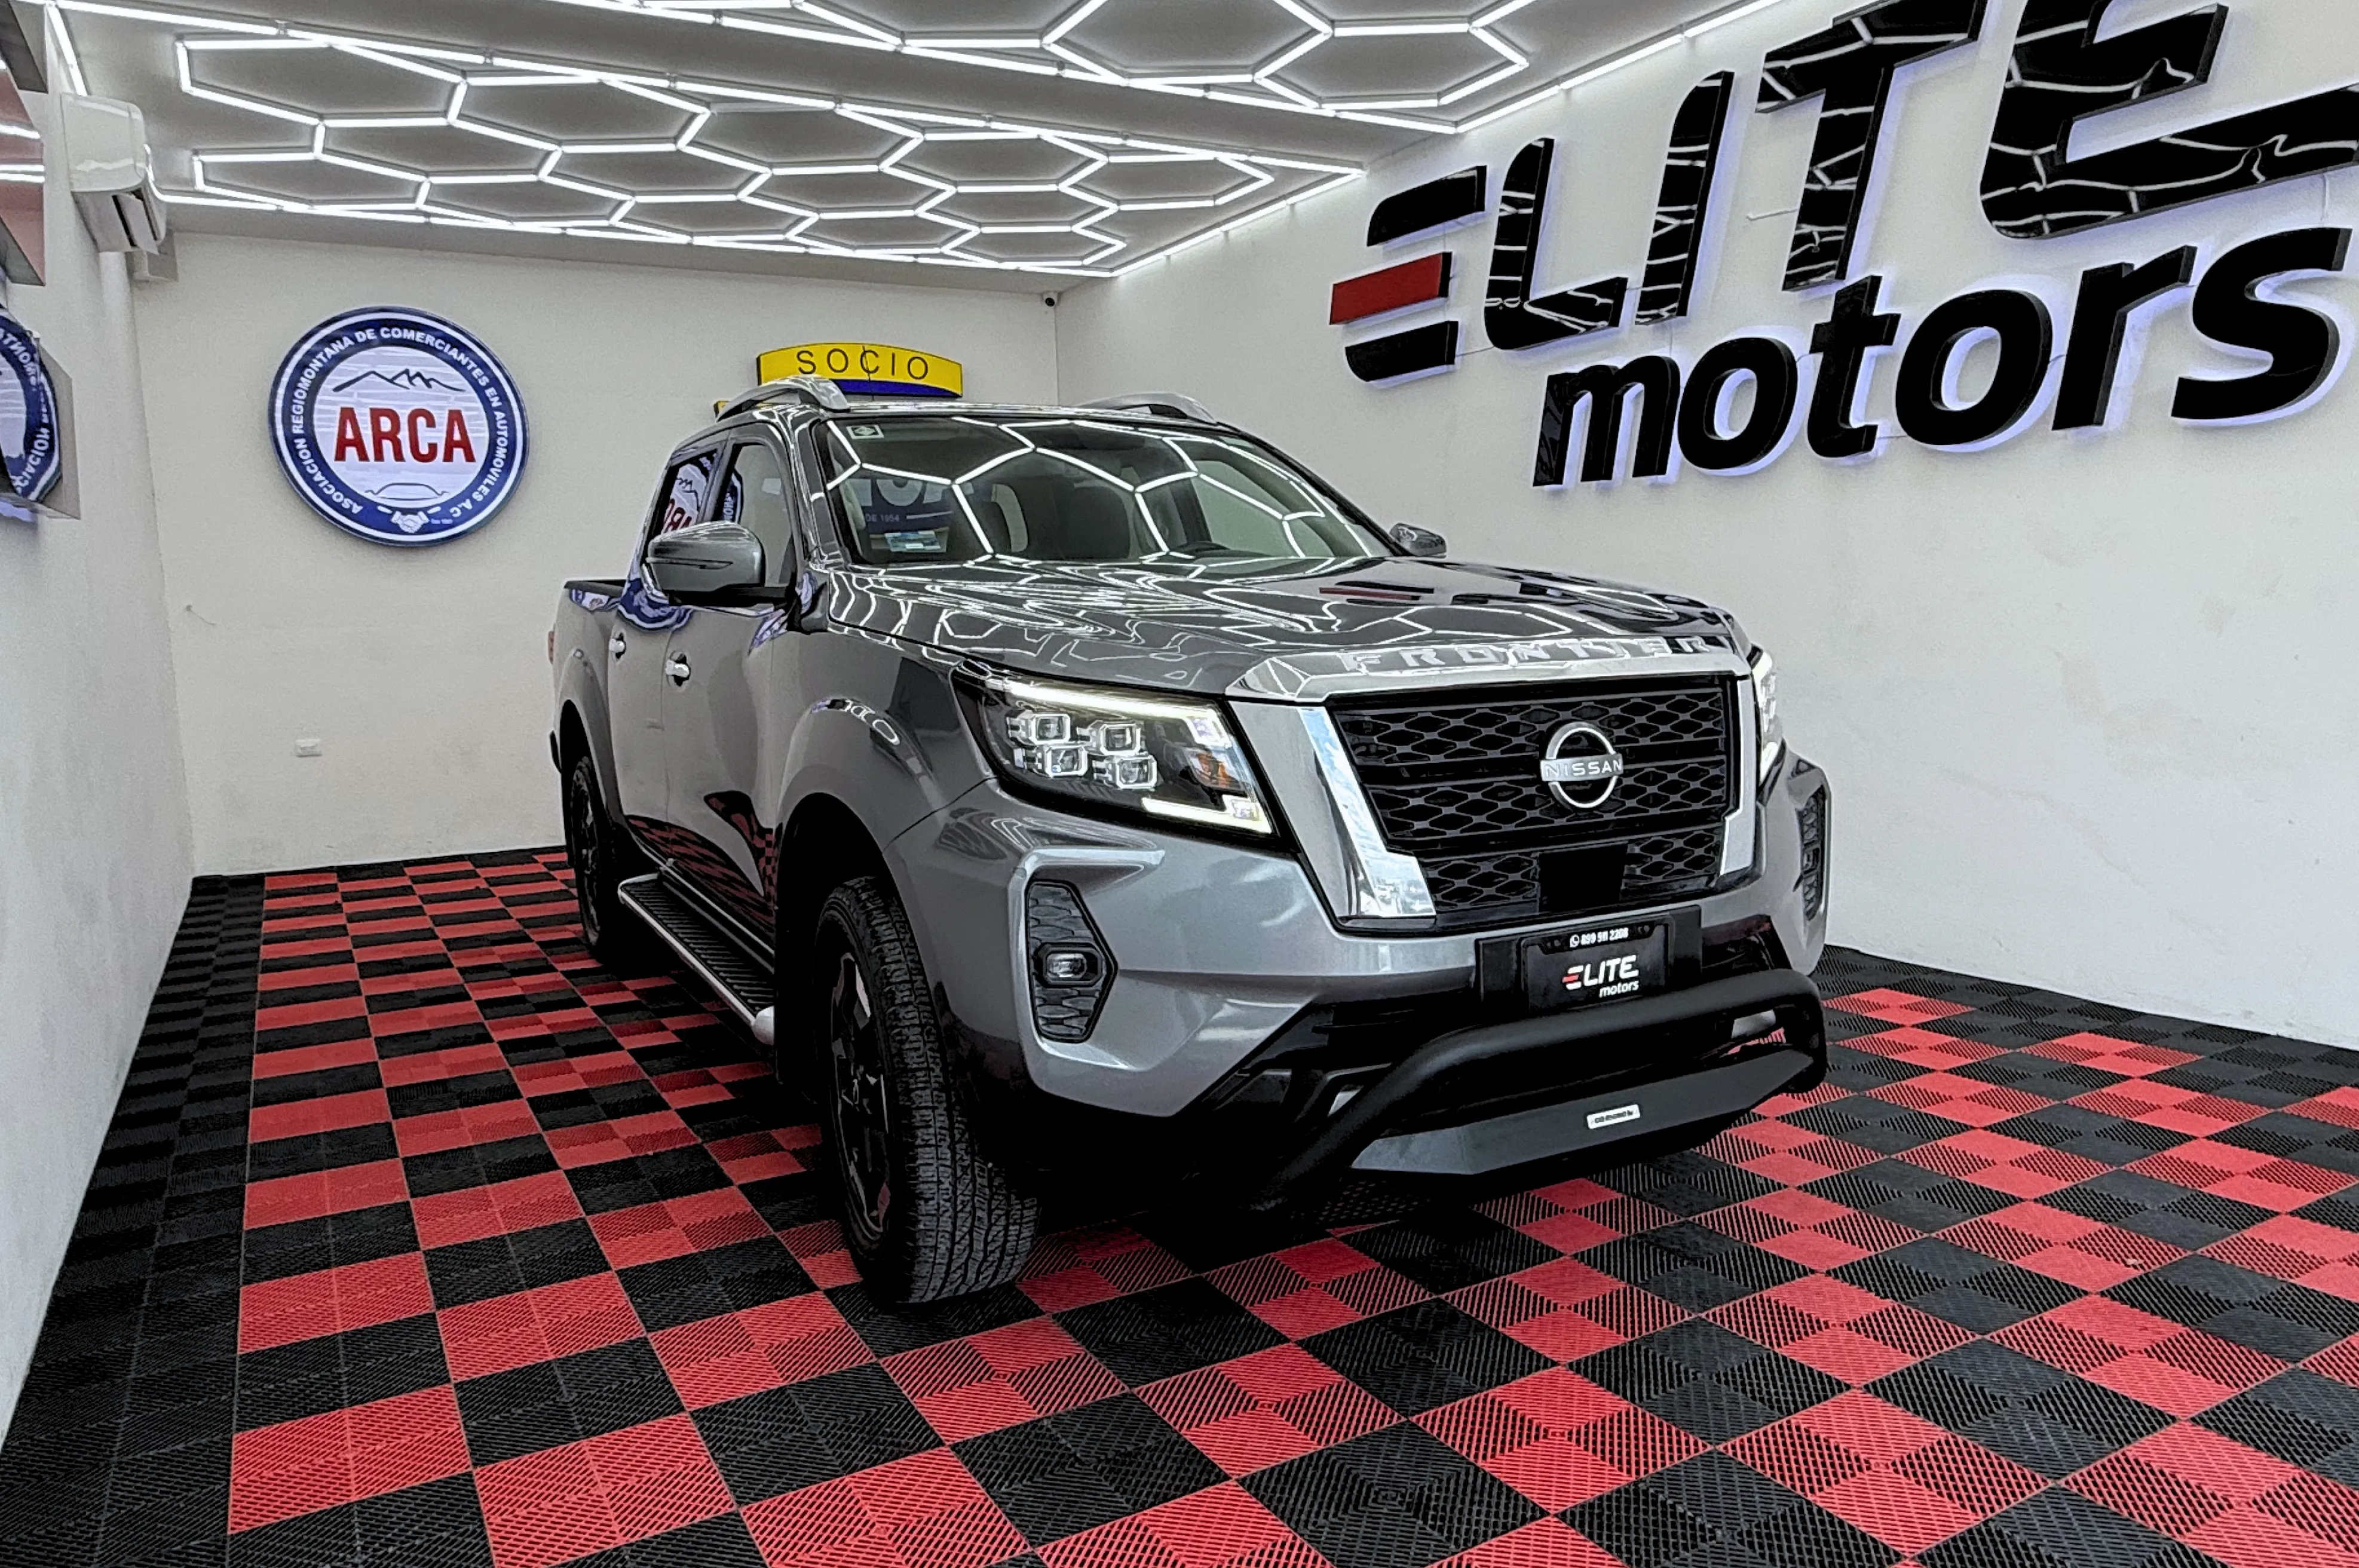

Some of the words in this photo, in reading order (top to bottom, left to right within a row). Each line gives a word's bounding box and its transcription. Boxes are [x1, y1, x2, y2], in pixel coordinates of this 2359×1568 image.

[1328, 0, 2359, 384] ELITE
[354, 328, 377, 343] DE
[379, 326, 488, 388] COMERCIANTES
[1532, 226, 2353, 487] motors
[292, 336, 356, 433] REGIOMONTANA
[796, 348, 929, 380] SOCIO
[485, 388, 502, 409] EN
[333, 407, 476, 464] ARCA
[472, 411, 509, 502] AUTOMOVILES
[294, 437, 363, 514] ASOCIACION
[1337, 636, 1711, 672] FRONTIER
[1545, 757, 1622, 777] NISSAN
[1562, 955, 1640, 990] ELITE
[1598, 980, 1640, 998] motors
